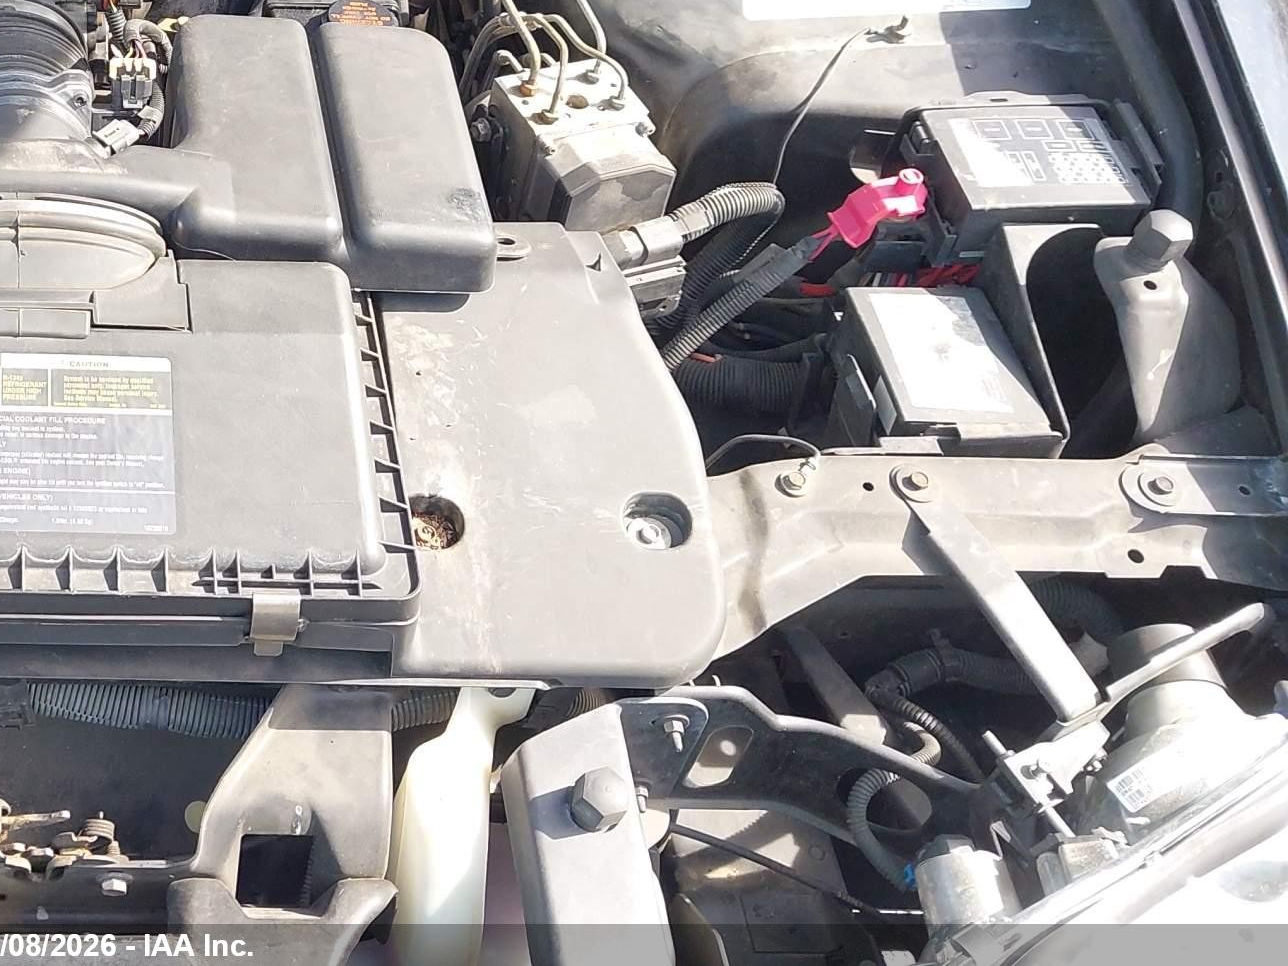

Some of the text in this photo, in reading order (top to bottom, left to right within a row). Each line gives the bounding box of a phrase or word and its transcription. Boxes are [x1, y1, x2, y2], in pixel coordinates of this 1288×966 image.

[69, 360, 110, 368] CAUTION
[15, 415, 47, 423] COOLANT
[64, 416, 106, 424] PROCEDURE
[34, 494, 53, 502] ONLY)
